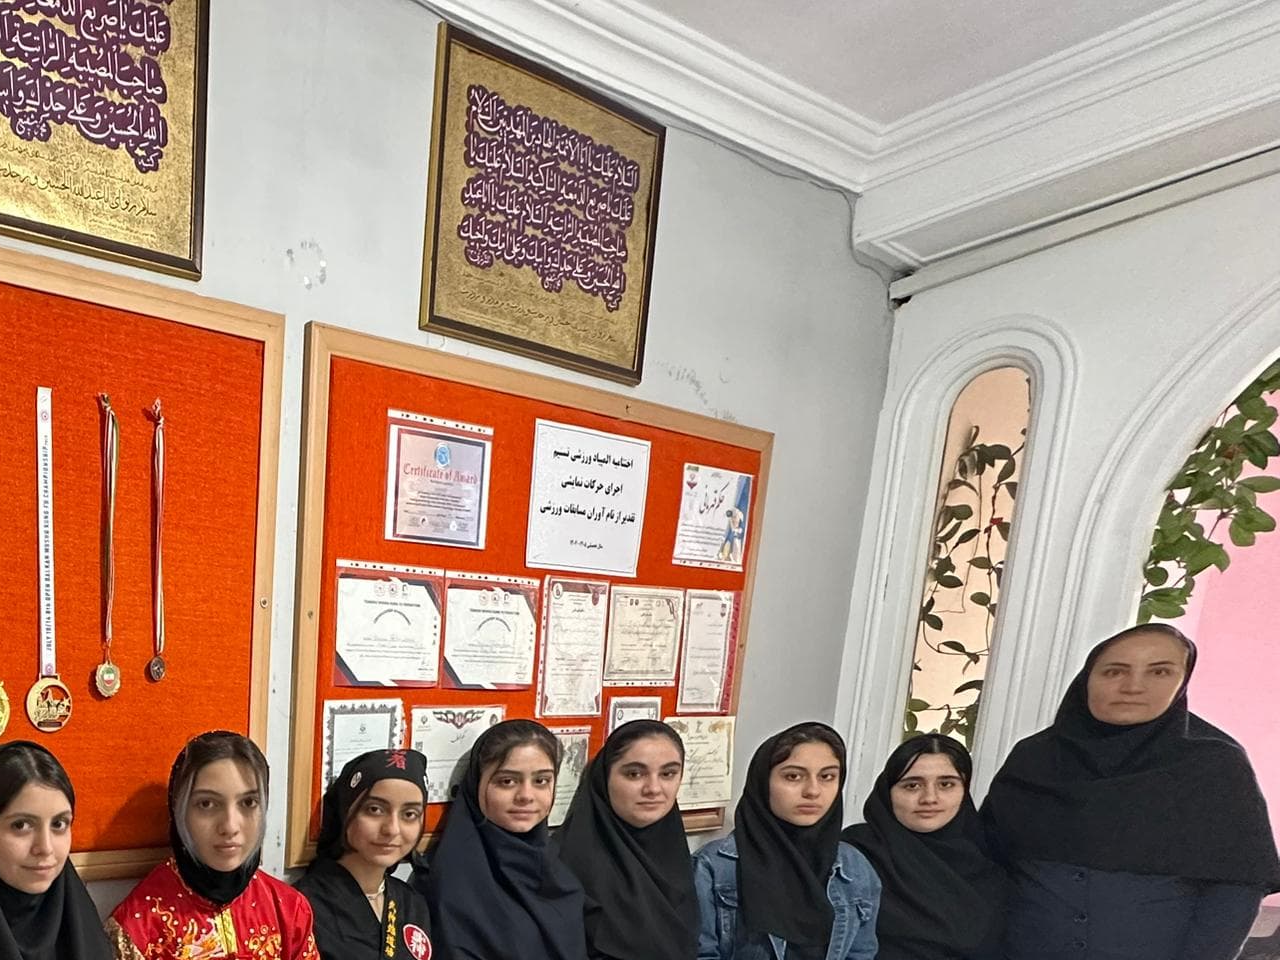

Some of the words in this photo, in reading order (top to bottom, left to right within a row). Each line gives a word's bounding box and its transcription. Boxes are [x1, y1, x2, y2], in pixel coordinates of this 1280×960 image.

[403, 462, 444, 480] Certificate
[445, 468, 452, 480] of
[454, 468, 478, 485] Award
